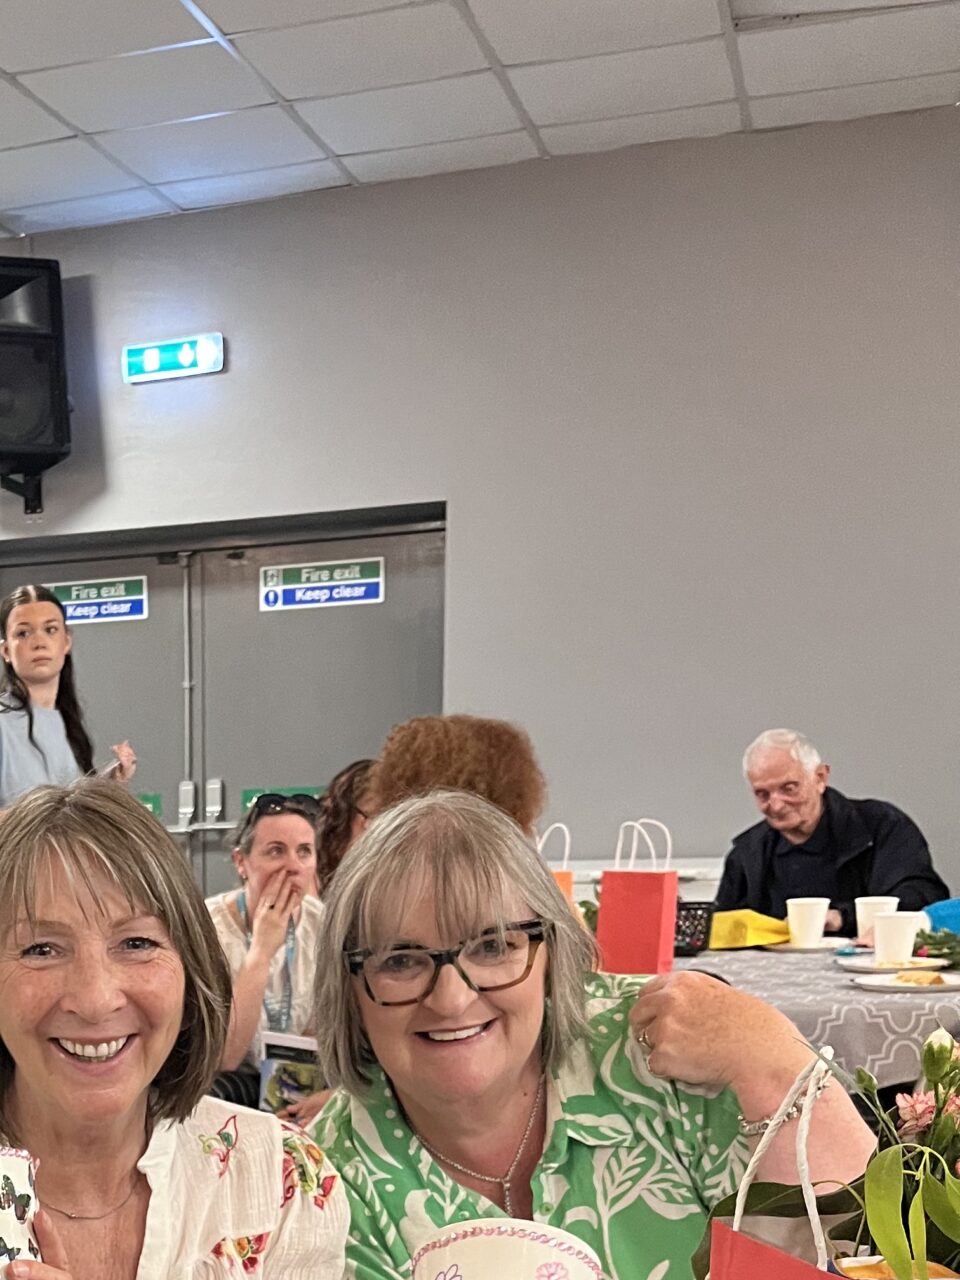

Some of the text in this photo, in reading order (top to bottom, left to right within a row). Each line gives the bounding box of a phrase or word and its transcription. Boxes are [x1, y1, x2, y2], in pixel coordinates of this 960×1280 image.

[301, 565, 361, 583] Fire exit
[71, 582, 126, 600] Fire exit
[295, 585, 366, 603] Keep clear
[66, 602, 132, 619] Keep clear
